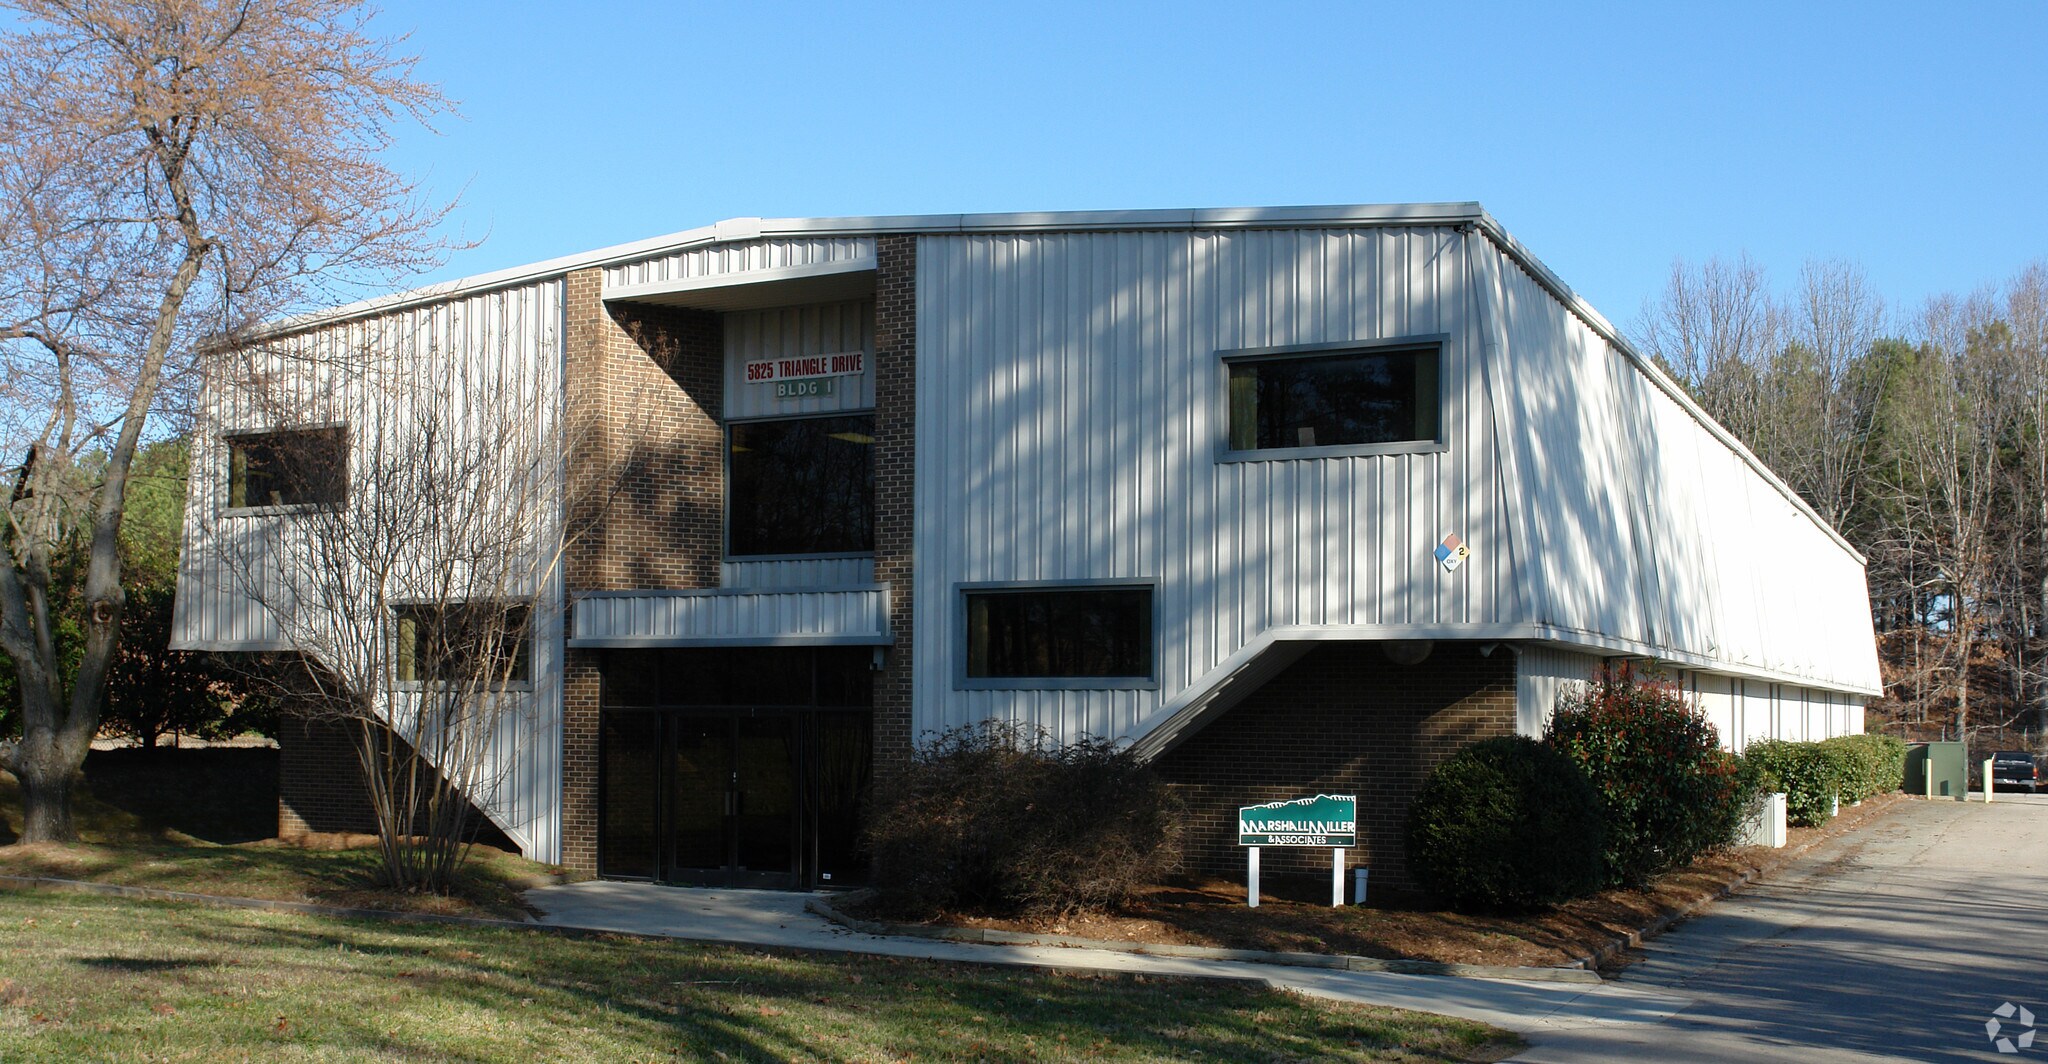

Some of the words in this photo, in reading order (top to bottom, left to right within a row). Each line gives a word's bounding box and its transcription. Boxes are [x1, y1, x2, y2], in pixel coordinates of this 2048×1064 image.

[748, 362, 774, 380] 5825
[778, 358, 827, 377] TRIANGLE
[831, 354, 862, 373] DRIVE
[778, 382, 817, 396] BLDG
[1458, 547, 1465, 556] 2
